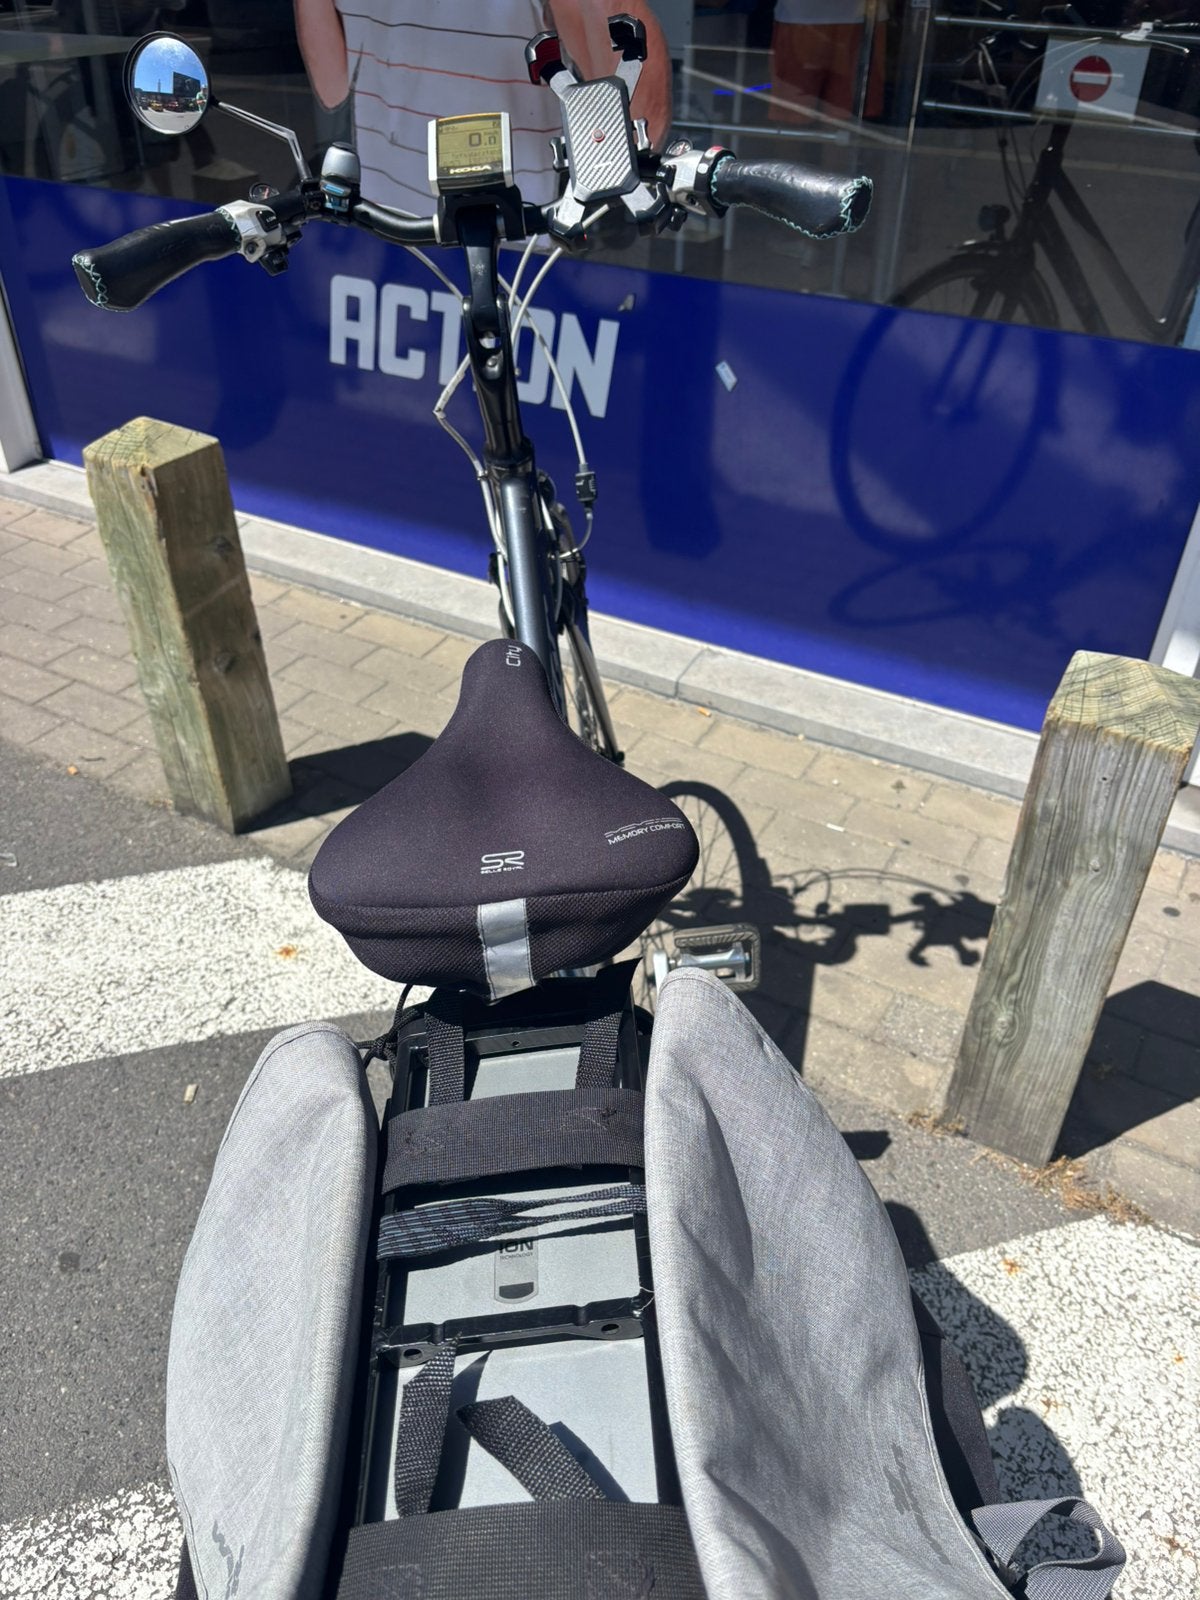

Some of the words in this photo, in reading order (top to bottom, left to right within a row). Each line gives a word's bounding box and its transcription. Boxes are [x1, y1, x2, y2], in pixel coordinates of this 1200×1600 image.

[449, 165, 492, 175] KOGA
[329, 274, 621, 419] ACTON
[608, 826, 649, 845] MEMORY
[649, 823, 686, 832] COMFORT
[480, 850, 525, 870] SR
